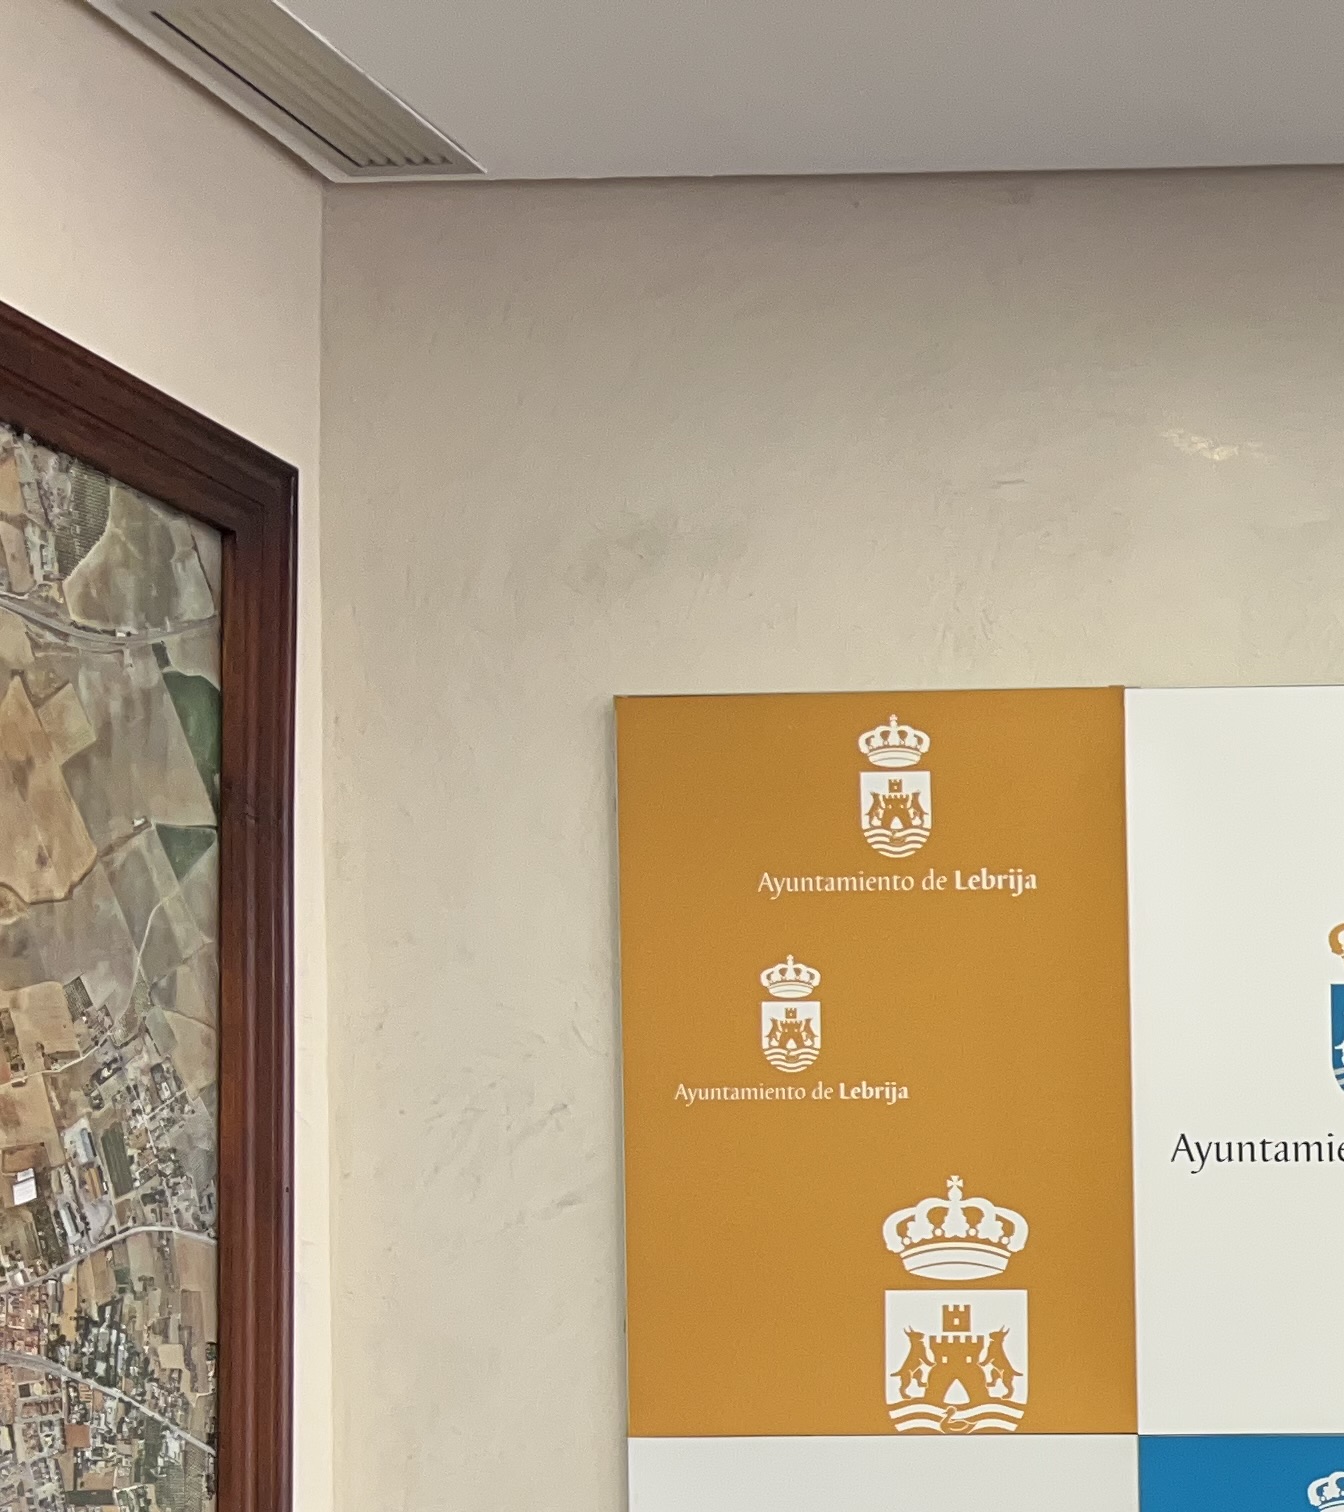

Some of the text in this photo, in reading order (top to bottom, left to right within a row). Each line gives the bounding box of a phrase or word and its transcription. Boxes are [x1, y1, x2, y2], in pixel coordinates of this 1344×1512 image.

[757, 867, 1038, 899] Ayuntamiento de Lebrija
[674, 1080, 909, 1106] Ayuntamiento de Lebrija
